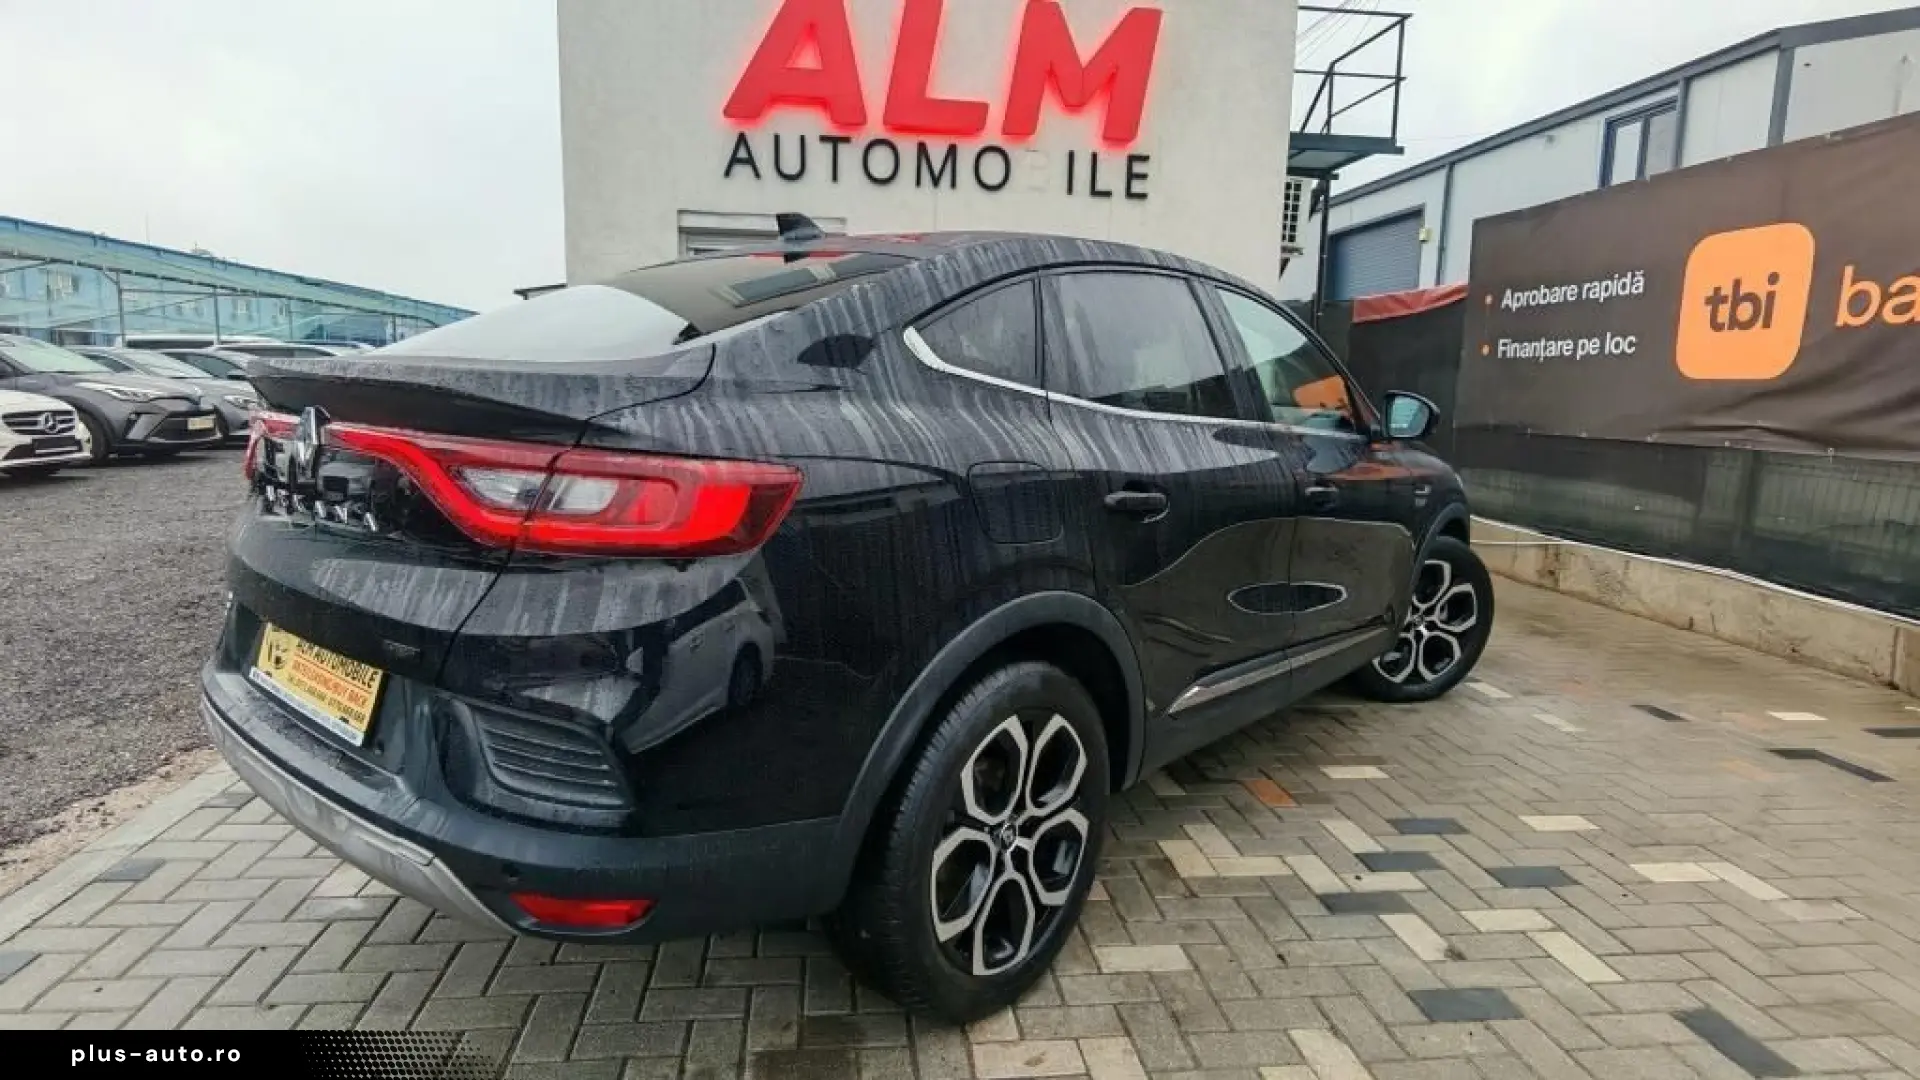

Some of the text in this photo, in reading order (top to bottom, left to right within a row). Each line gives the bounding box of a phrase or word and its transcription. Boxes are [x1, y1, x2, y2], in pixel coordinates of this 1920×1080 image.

[723, 0, 1162, 143] ALM
[723, 131, 1151, 200] AUTOMOILE
[1501, 270, 1645, 312] Aprobare rapidă
[1704, 271, 1780, 332] tbi
[1576, 336, 1600, 360] pe
[1604, 331, 1637, 355] loc
